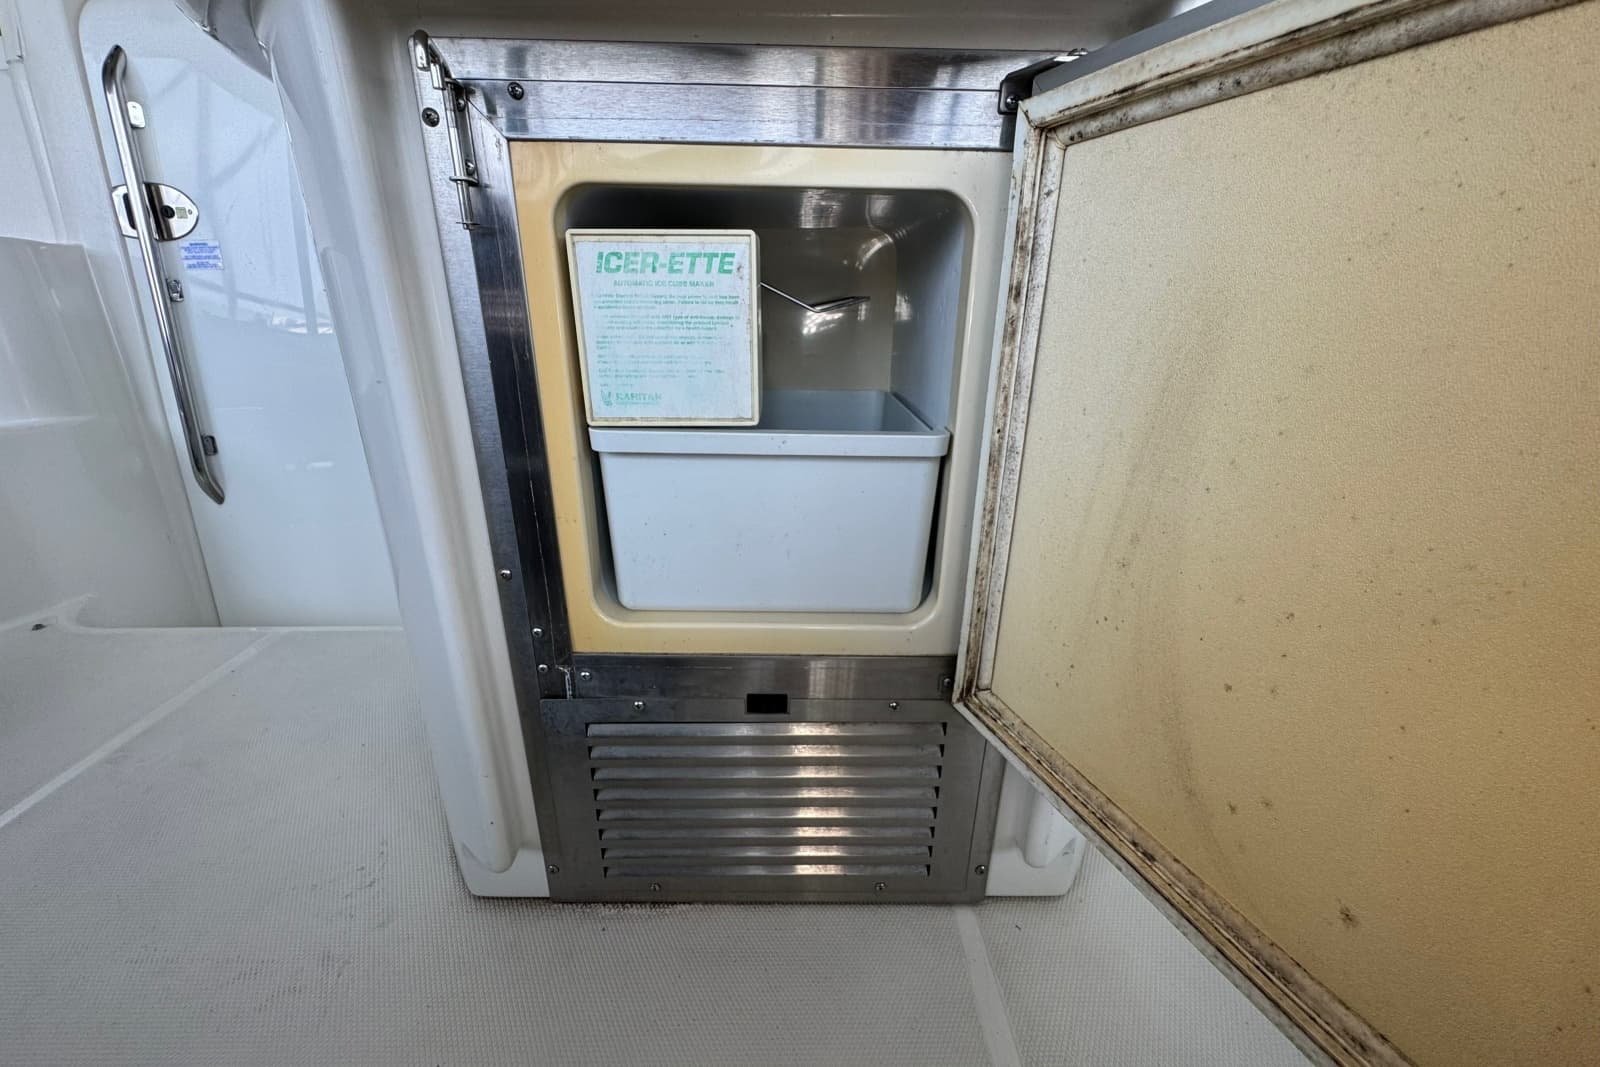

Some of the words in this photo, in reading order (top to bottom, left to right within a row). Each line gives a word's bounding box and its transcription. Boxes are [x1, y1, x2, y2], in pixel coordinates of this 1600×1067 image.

[596, 251, 735, 274] ICER-ETTE
[613, 279, 653, 288] AUTOMATIC
[654, 279, 667, 288] ICE
